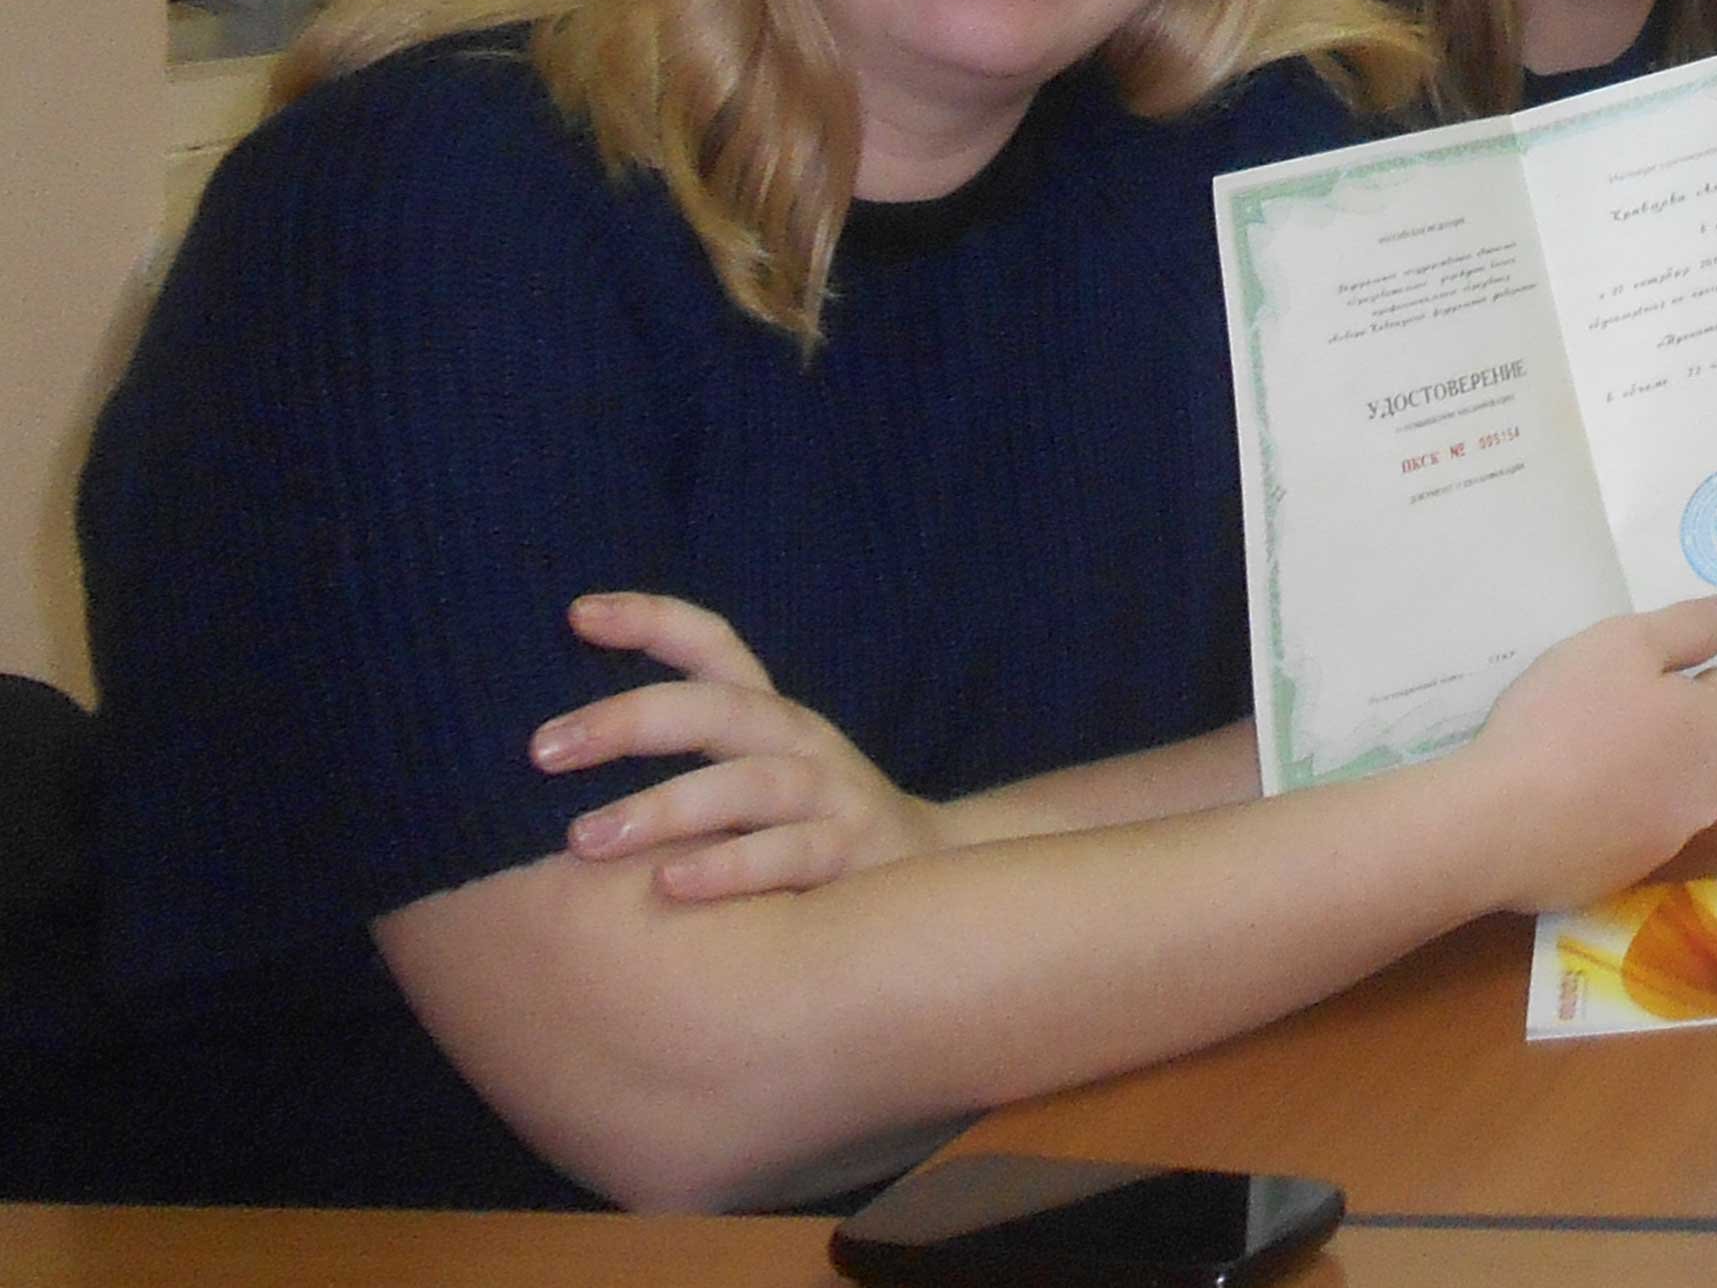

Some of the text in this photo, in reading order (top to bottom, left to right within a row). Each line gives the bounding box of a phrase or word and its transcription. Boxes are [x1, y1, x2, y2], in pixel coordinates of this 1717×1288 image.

[1366, 357, 1529, 420] УДОСТОВЕРЕНИЕ
[1400, 451, 1441, 474] ПКСК
[1449, 441, 1467, 460] №
